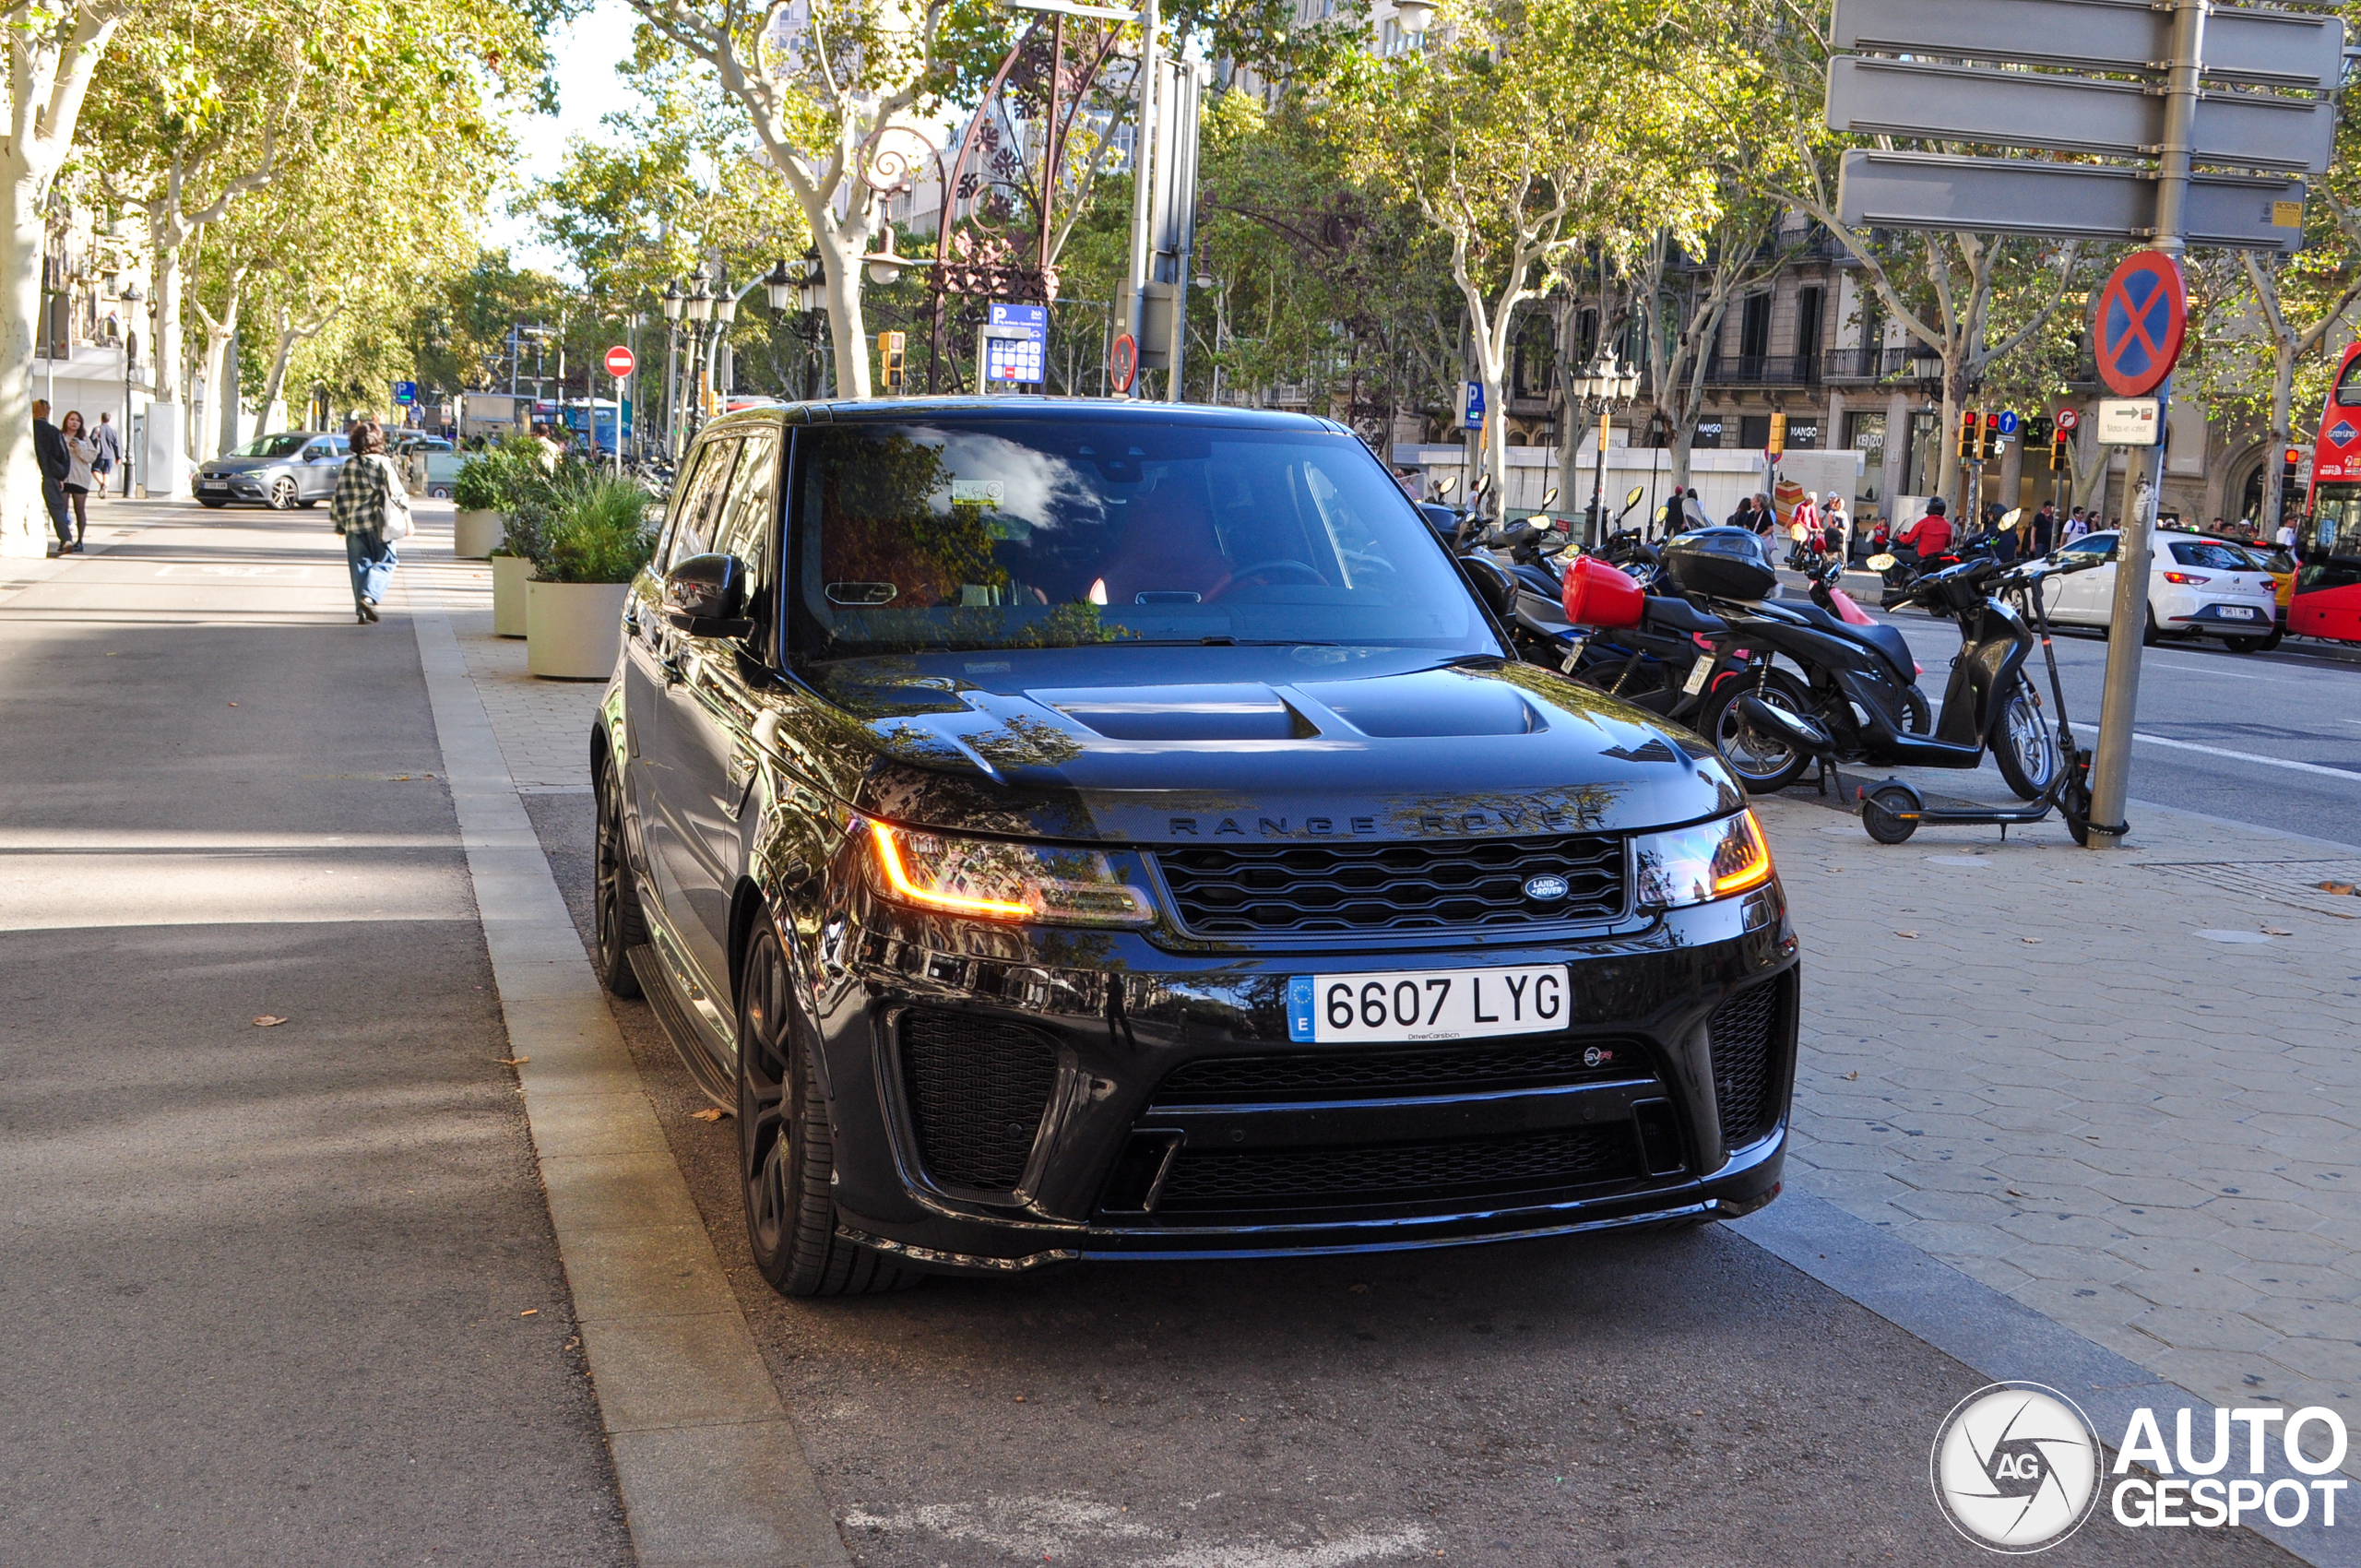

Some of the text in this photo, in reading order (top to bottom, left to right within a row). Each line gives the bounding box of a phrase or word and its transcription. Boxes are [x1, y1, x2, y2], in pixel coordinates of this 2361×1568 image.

[993, 307, 1007, 324] P
[397, 383, 407, 395] P
[1467, 385, 1478, 408] P
[1698, 422, 1722, 434] MANGO
[1790, 426, 1818, 437] MANGO
[1856, 434, 1883, 447] KENZO
[2220, 607, 2237, 615] 7961
[1169, 806, 1606, 834] RANGE ROVER
[1533, 879, 1555, 888] LAND
[1536, 886, 1562, 896] ROVER
[1326, 974, 1560, 1029] 6607 LYG
[1298, 1017, 1309, 1031] E
[1407, 1032, 1460, 1040] DriverCarsbcn
[1584, 1047, 1613, 1067] SVR
